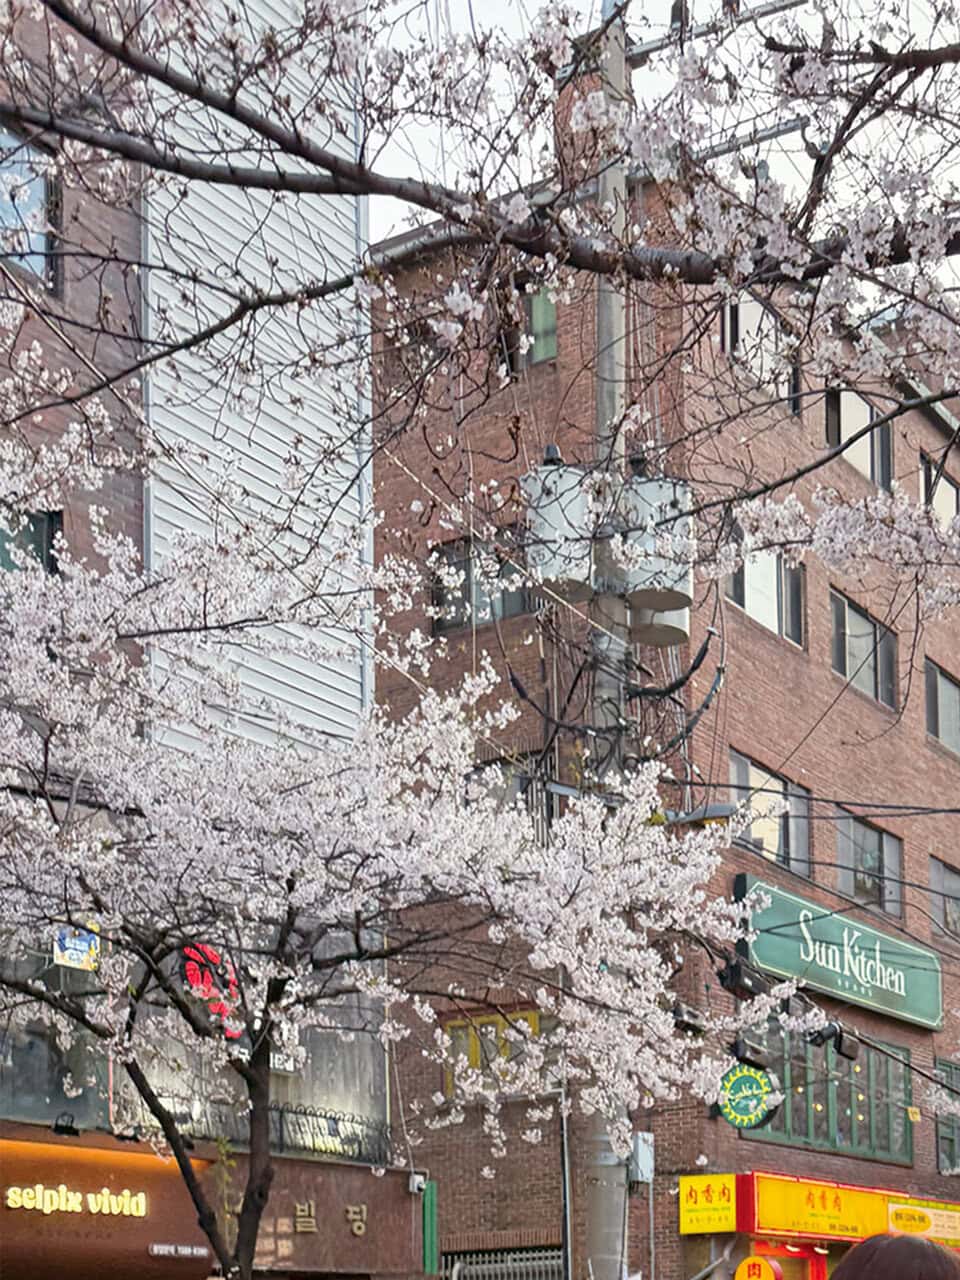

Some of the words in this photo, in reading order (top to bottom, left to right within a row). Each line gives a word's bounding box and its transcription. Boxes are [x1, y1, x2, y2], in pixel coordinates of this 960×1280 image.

[799, 908, 841, 976] Sun
[842, 927, 906, 998] Kitchen
[7, 1183, 83, 1215] selpix
[87, 1187, 147, 1217] vivid
